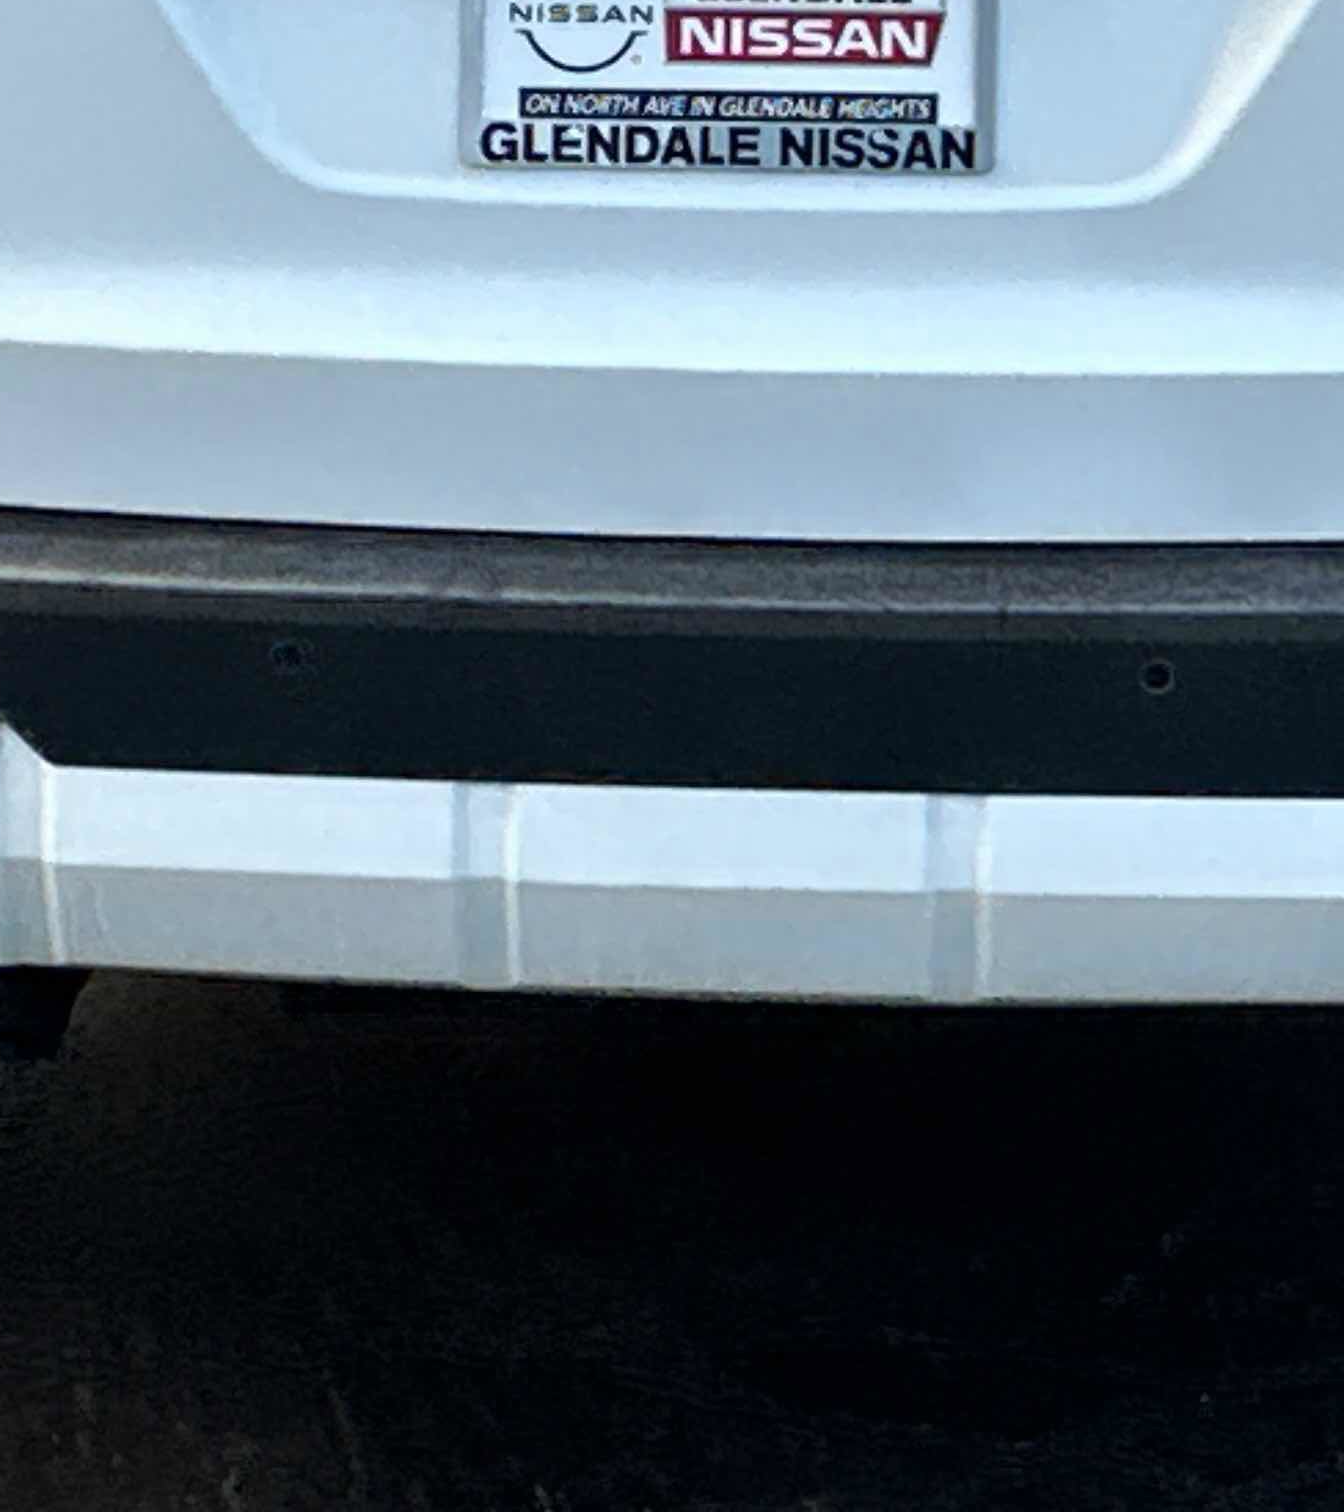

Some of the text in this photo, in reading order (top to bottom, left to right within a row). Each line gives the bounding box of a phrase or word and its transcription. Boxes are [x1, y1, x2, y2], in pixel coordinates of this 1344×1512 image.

[509, 2, 654, 26] NISSAN
[679, 16, 928, 59] NISSAN
[525, 92, 932, 120] ON NORTH AVE IN GLENDALE HEIGHTS
[480, 122, 976, 169] GLENDALE NISSAN
